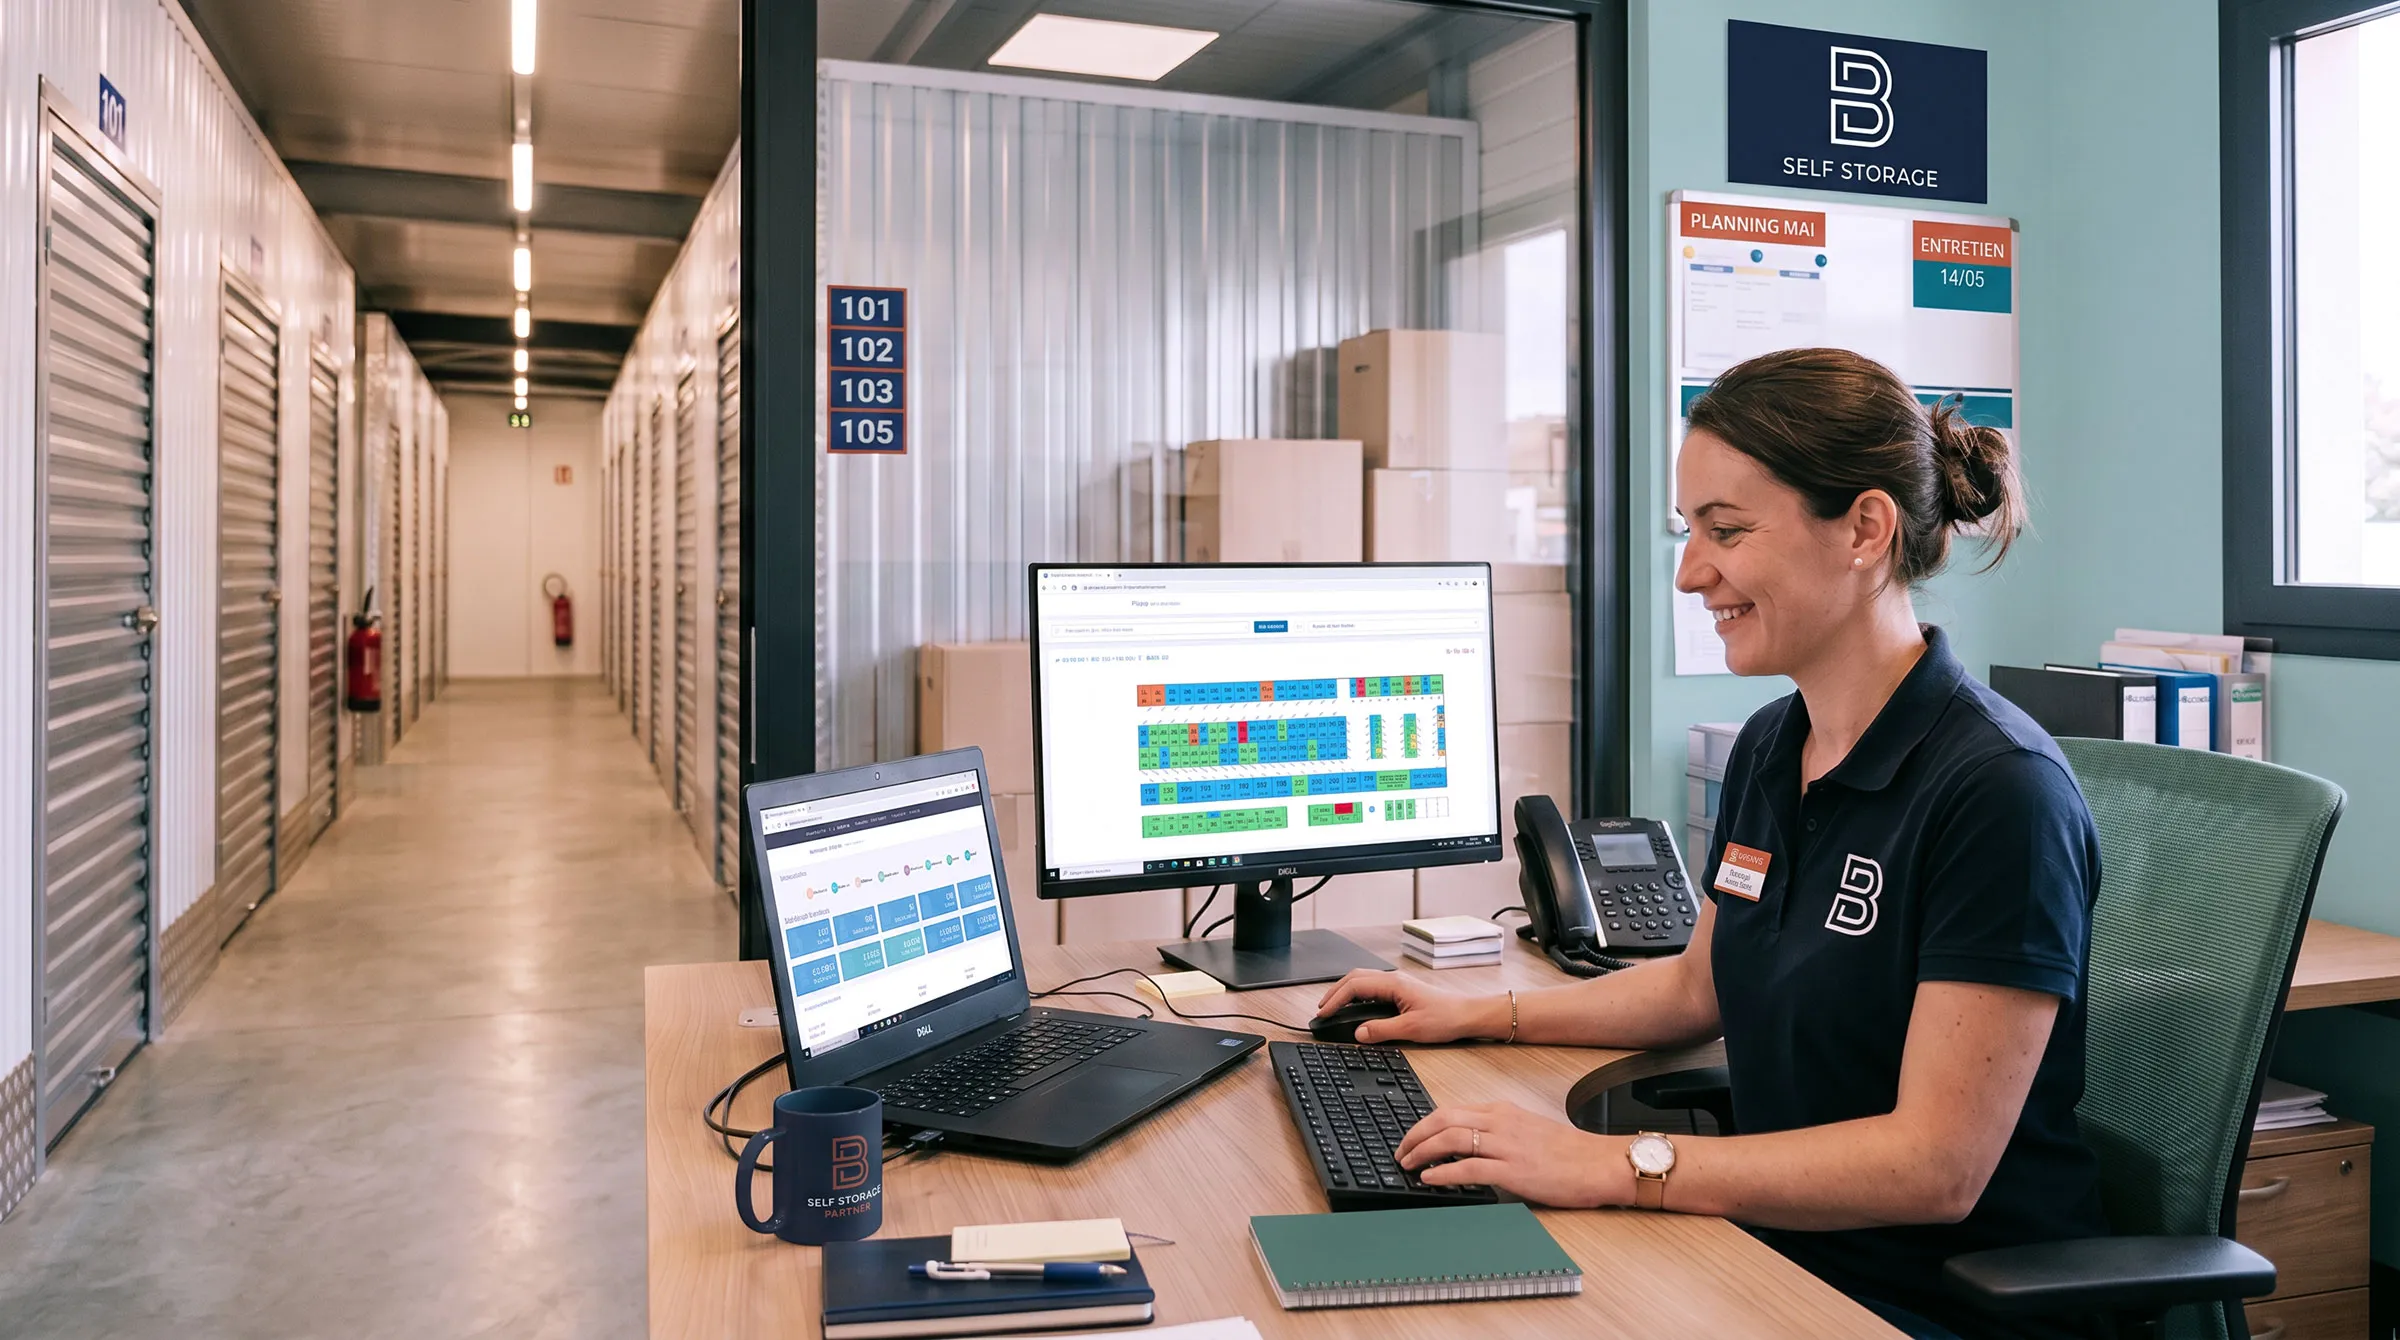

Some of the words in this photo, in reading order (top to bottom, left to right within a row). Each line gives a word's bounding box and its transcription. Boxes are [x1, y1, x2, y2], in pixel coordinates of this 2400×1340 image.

[1831, 45, 1894, 148] B
[102, 89, 123, 142] 101
[1783, 157, 1834, 178] SELF
[1841, 162, 1938, 188] STORAGE
[1691, 213, 1779, 235] PLANNING
[1784, 220, 1815, 237] MAI
[1921, 237, 2004, 259] ENTRETIEN
[1940, 268, 1985, 289] 14/05
[840, 296, 890, 322] 101
[840, 336, 894, 362] 102
[840, 378, 894, 404] 103
[840, 418, 894, 444] 105
[1824, 853, 1883, 936] B
[832, 1135, 869, 1191] B
[807, 1197, 835, 1208] SELF
[825, 1202, 871, 1218] PARTNER
